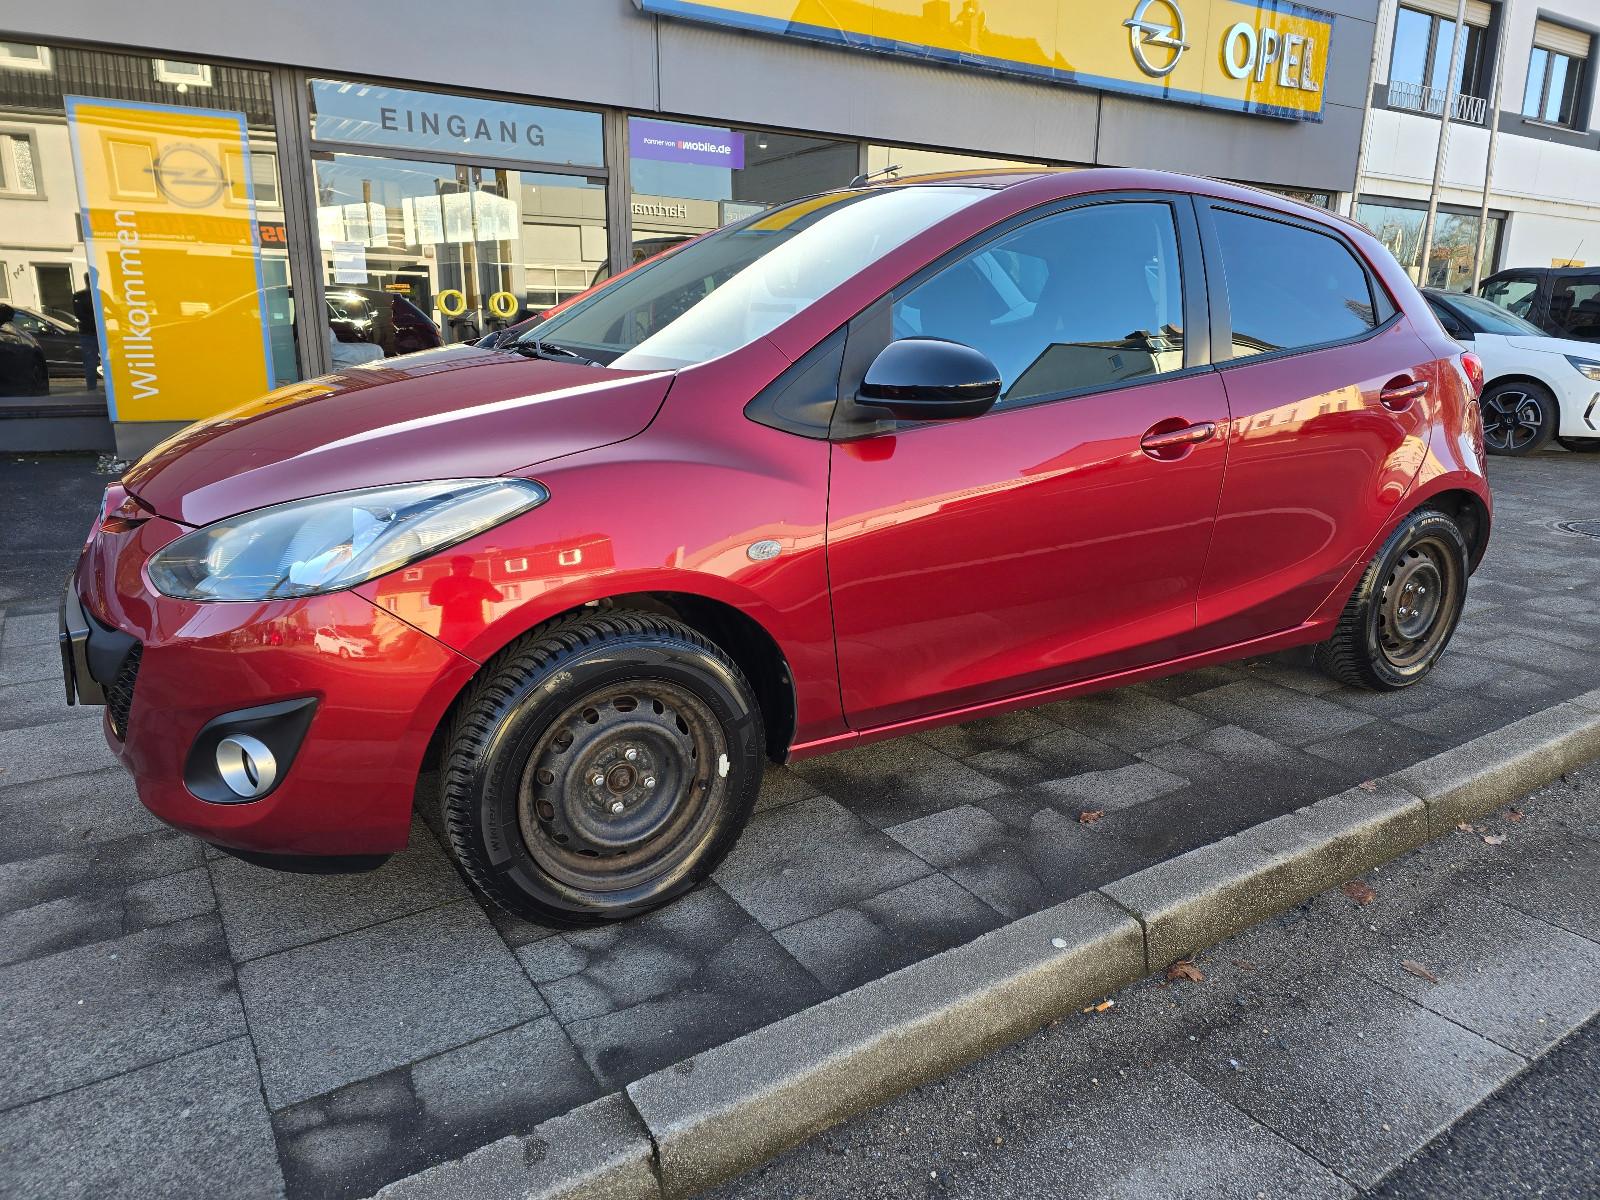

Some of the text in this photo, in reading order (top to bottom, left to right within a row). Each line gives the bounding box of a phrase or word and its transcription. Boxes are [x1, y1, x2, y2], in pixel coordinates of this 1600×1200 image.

[1224, 22, 1319, 92] OPEL
[380, 107, 545, 147] EINGANG
[643, 138, 732, 155] Partner von mobile.de
[114, 210, 160, 400] Willkommen
